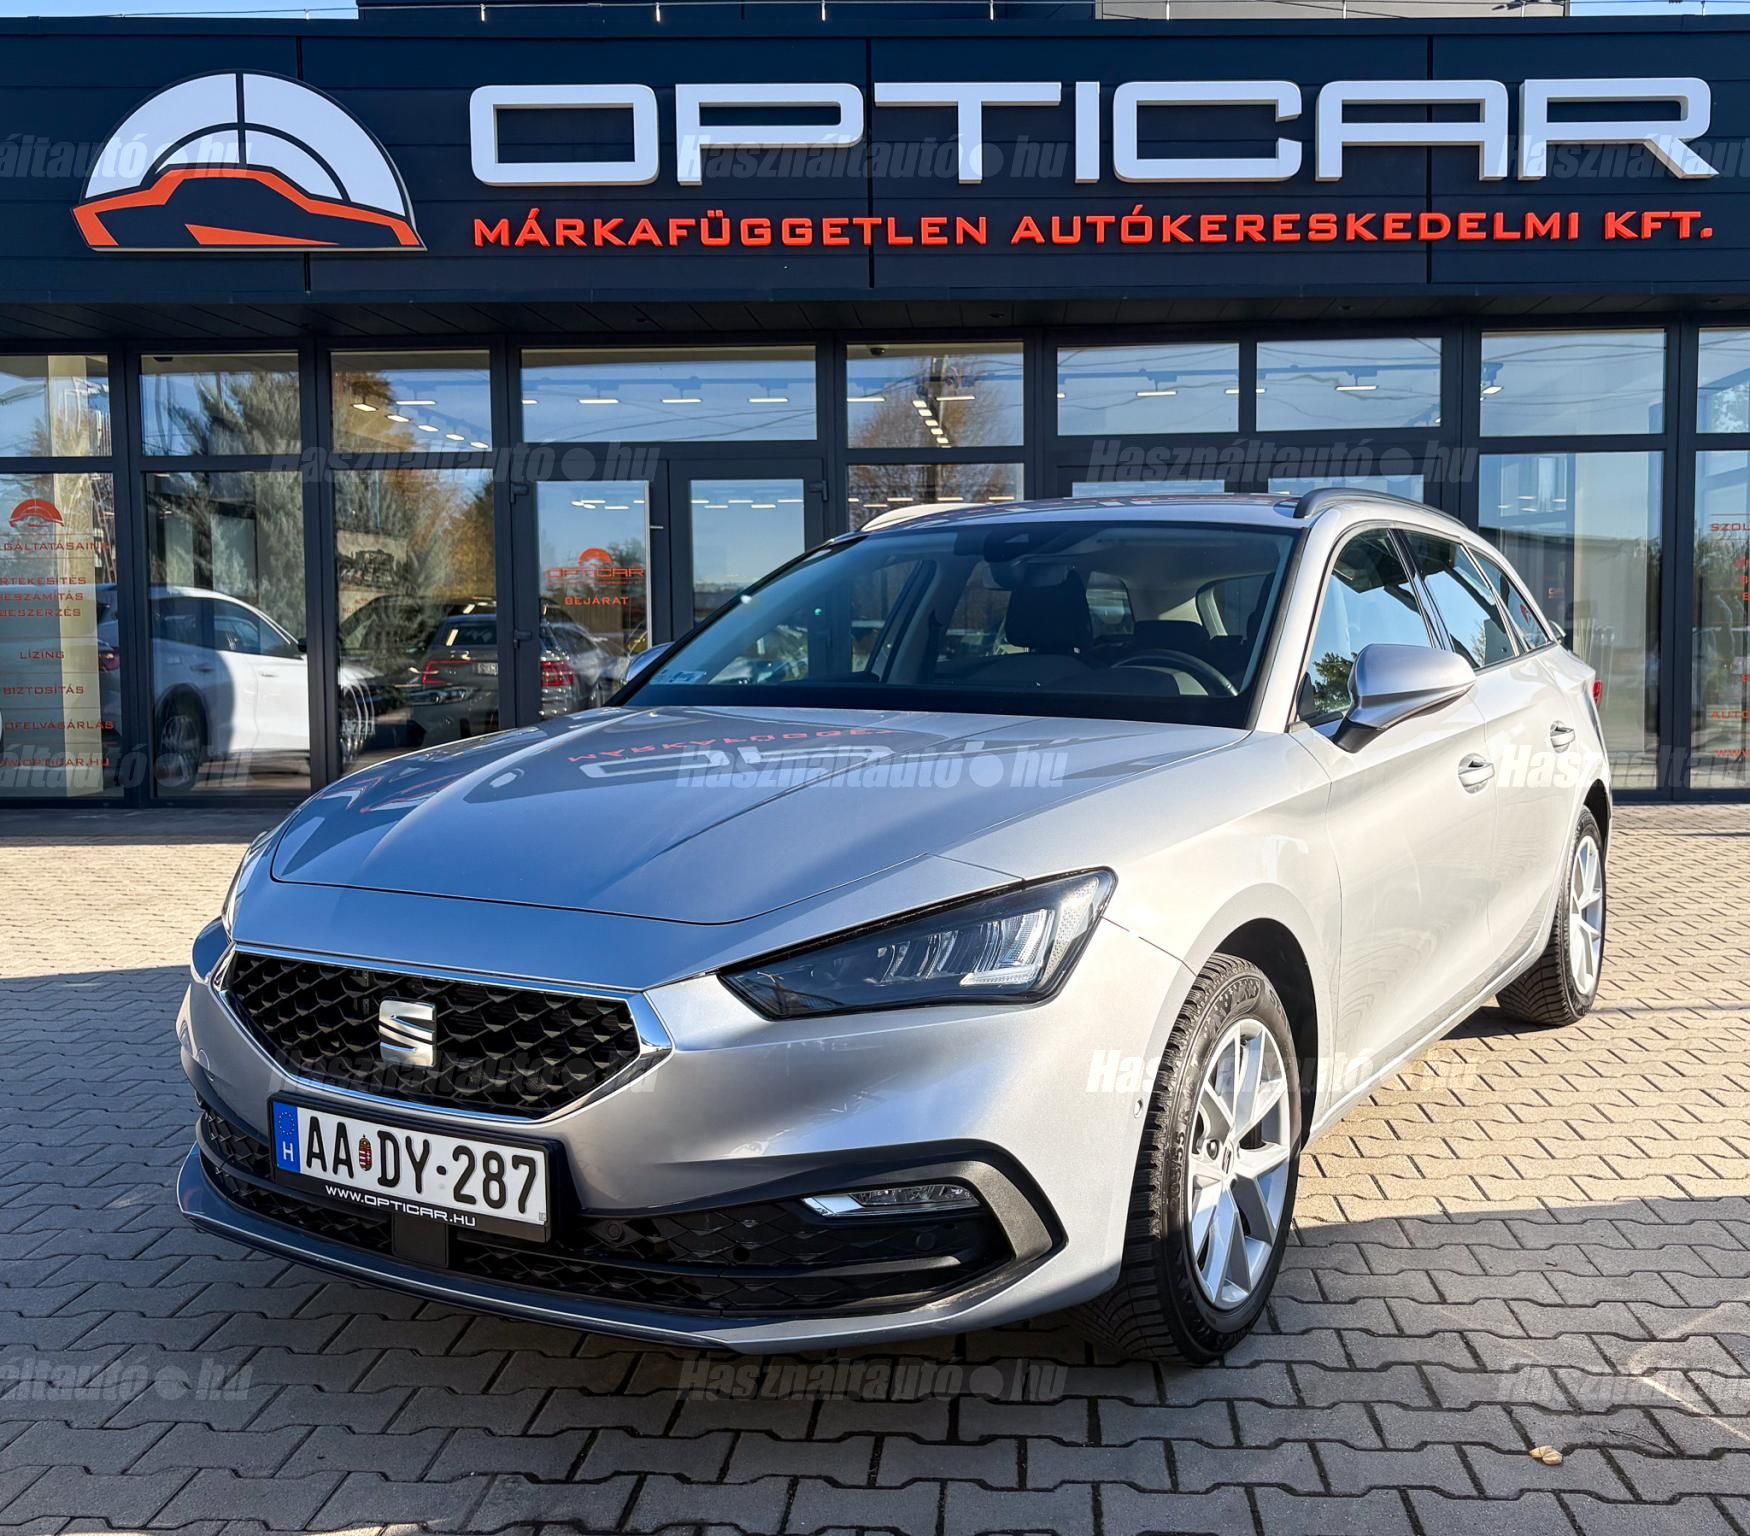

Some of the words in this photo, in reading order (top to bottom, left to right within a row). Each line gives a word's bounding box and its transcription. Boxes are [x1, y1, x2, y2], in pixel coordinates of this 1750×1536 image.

[470, 77, 1719, 186] OPTICAR
[474, 207, 987, 247] MÁRKAFÜGGETLEN
[1011, 204, 1580, 245] AUTÓKERESKEDELMI
[1605, 210, 1713, 241] KFT.
[20, 649, 65, 659] LÍZING
[282, 1140, 295, 1162] H
[325, 1184, 477, 1227] WWW.OPTICAR.HU
